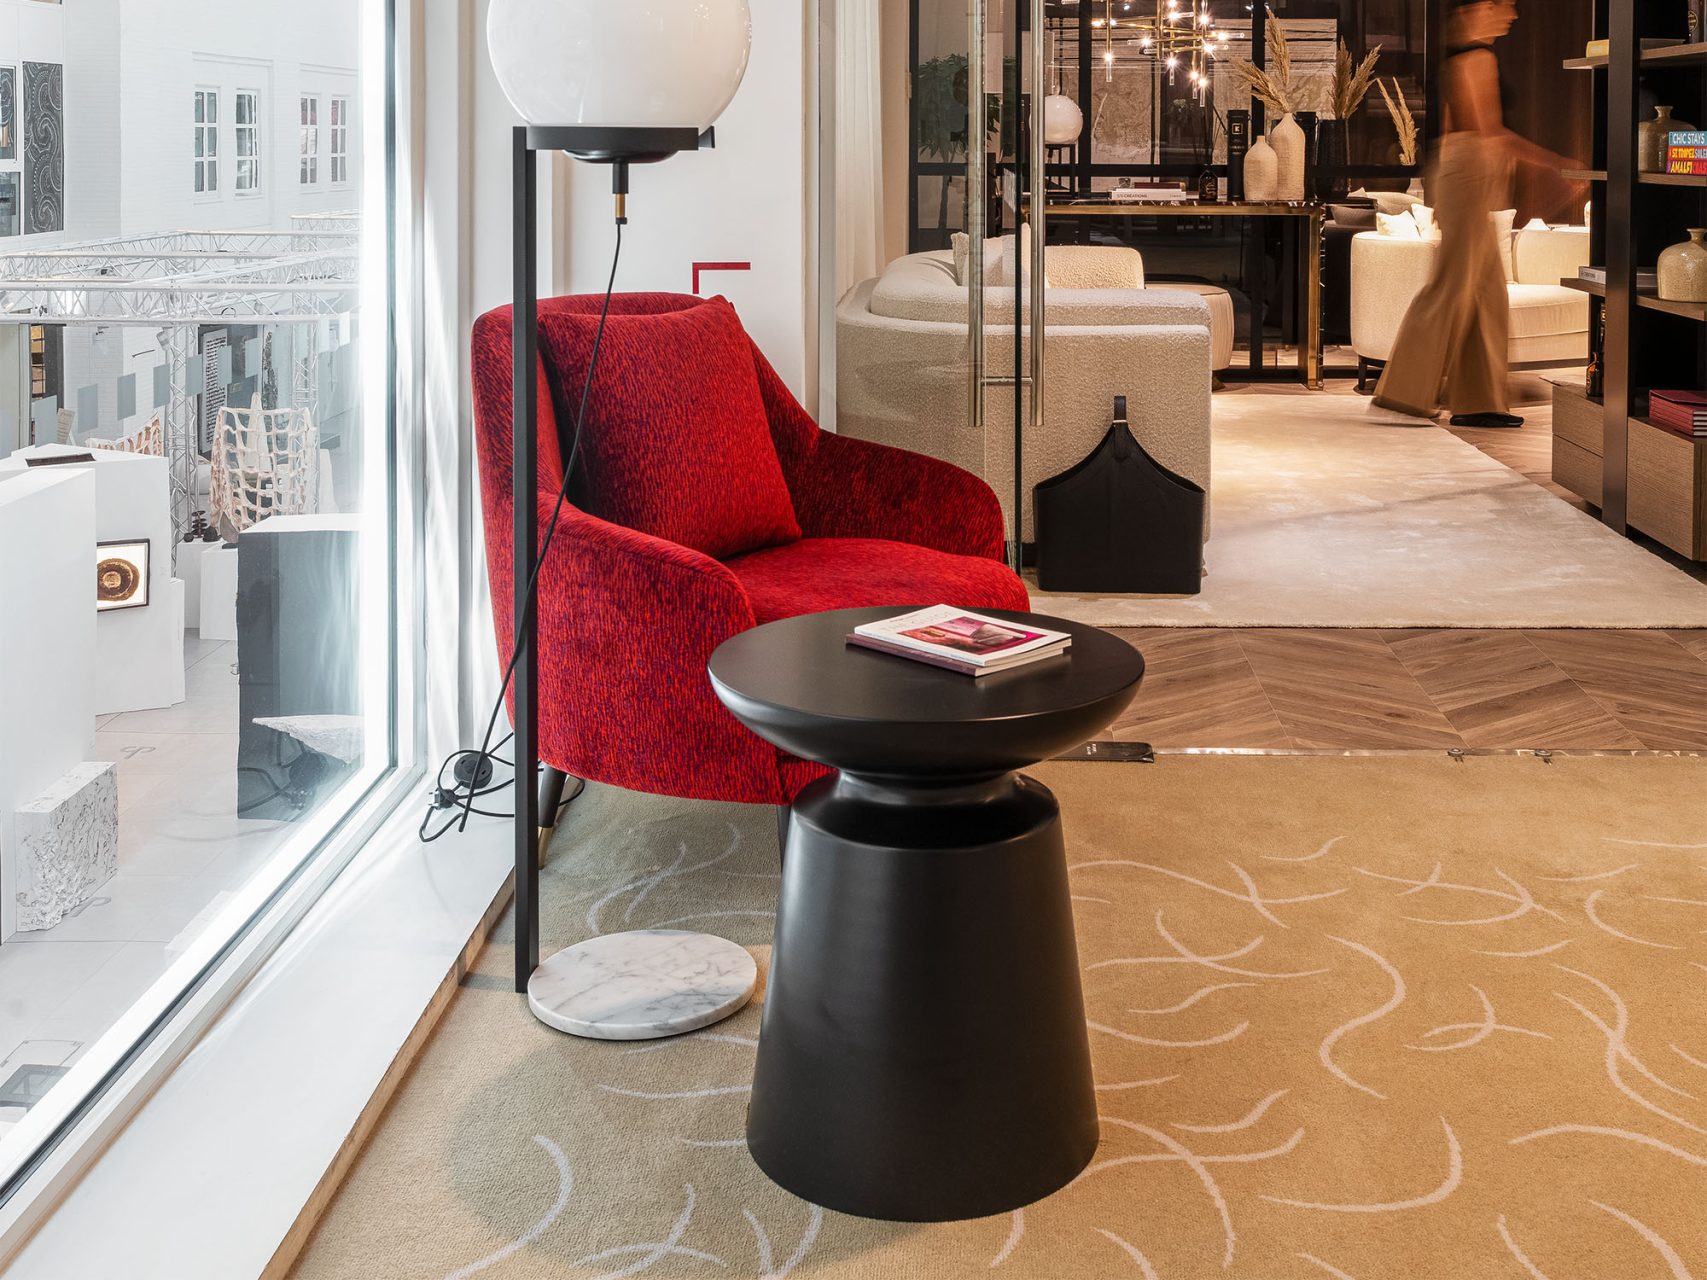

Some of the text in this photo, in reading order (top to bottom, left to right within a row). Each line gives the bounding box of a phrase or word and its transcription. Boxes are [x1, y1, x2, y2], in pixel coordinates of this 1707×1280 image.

[1673, 133, 1705, 144] CHIC STAYS
[1671, 161, 1693, 174] AMALFI
